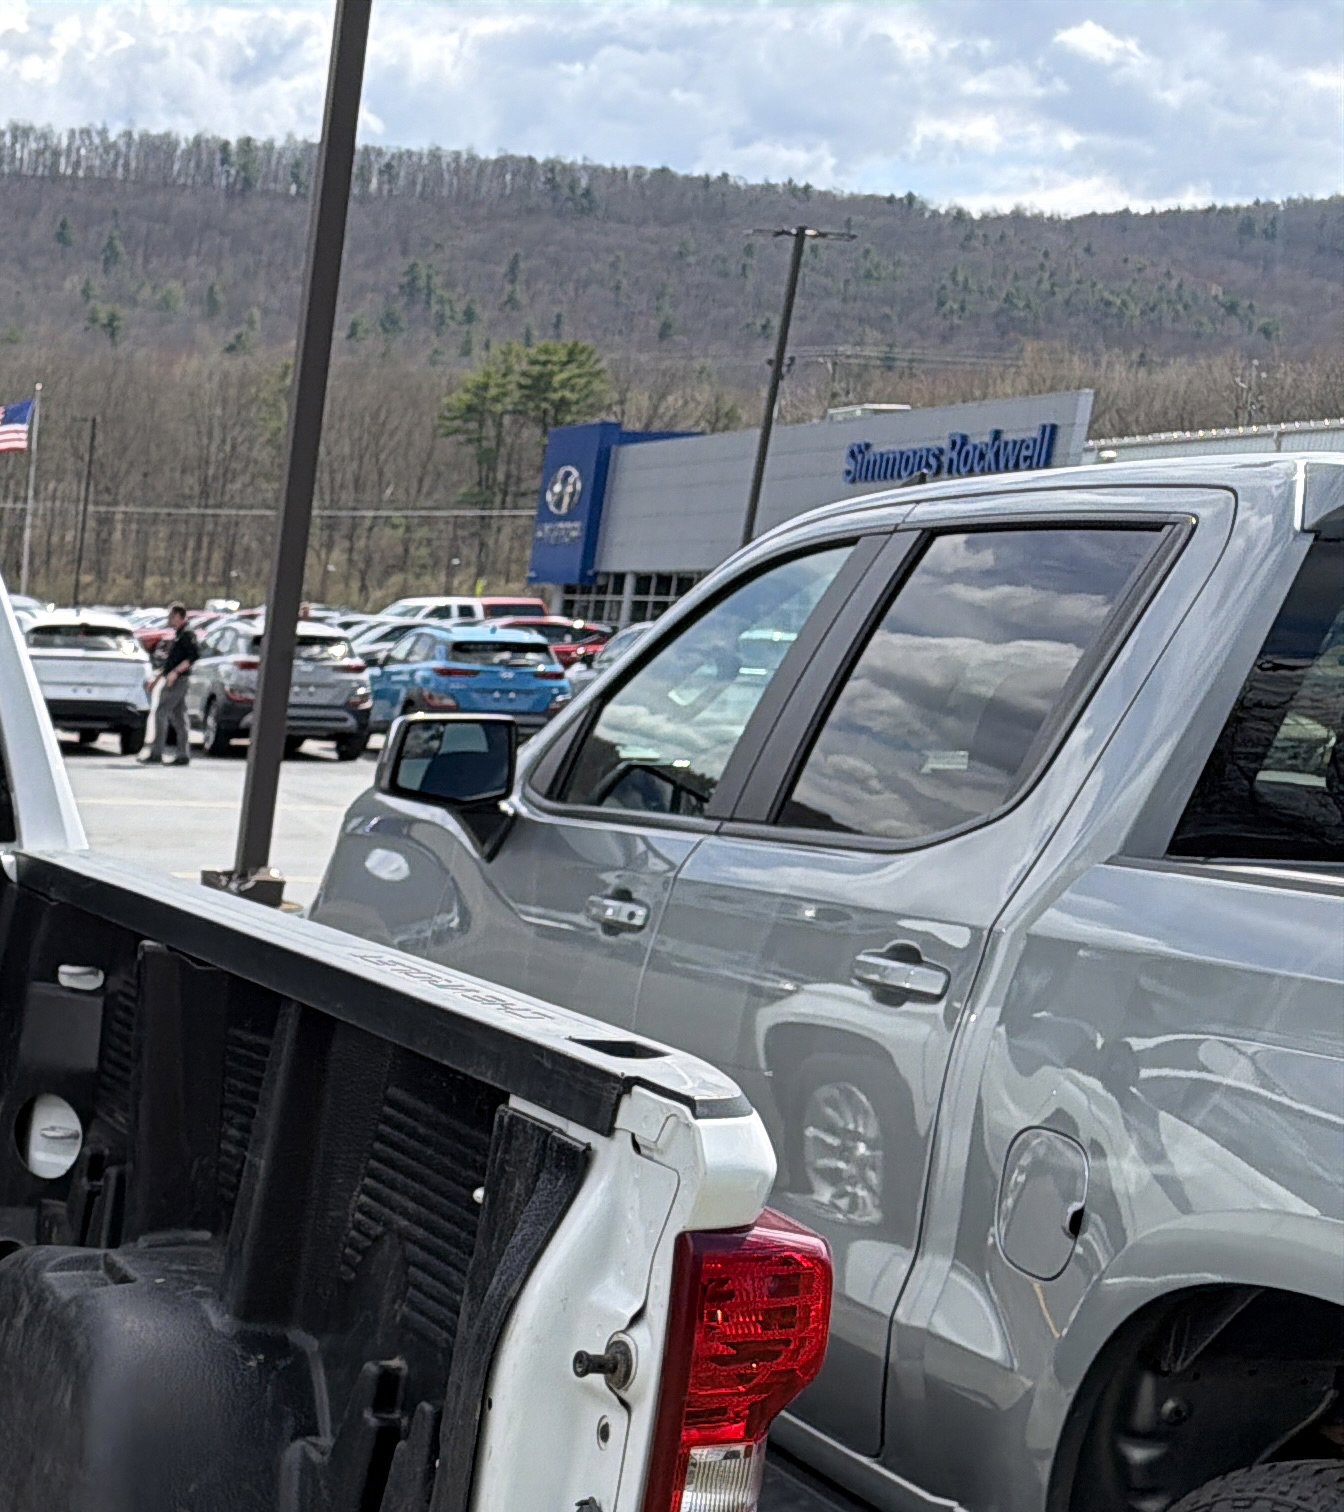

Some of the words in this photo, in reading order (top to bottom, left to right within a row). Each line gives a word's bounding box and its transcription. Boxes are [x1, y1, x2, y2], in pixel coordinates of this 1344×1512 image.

[843, 441, 944, 483] Simmons
[943, 423, 1058, 476] Rockwell
[350, 952, 556, 1020] CHEVROLET
